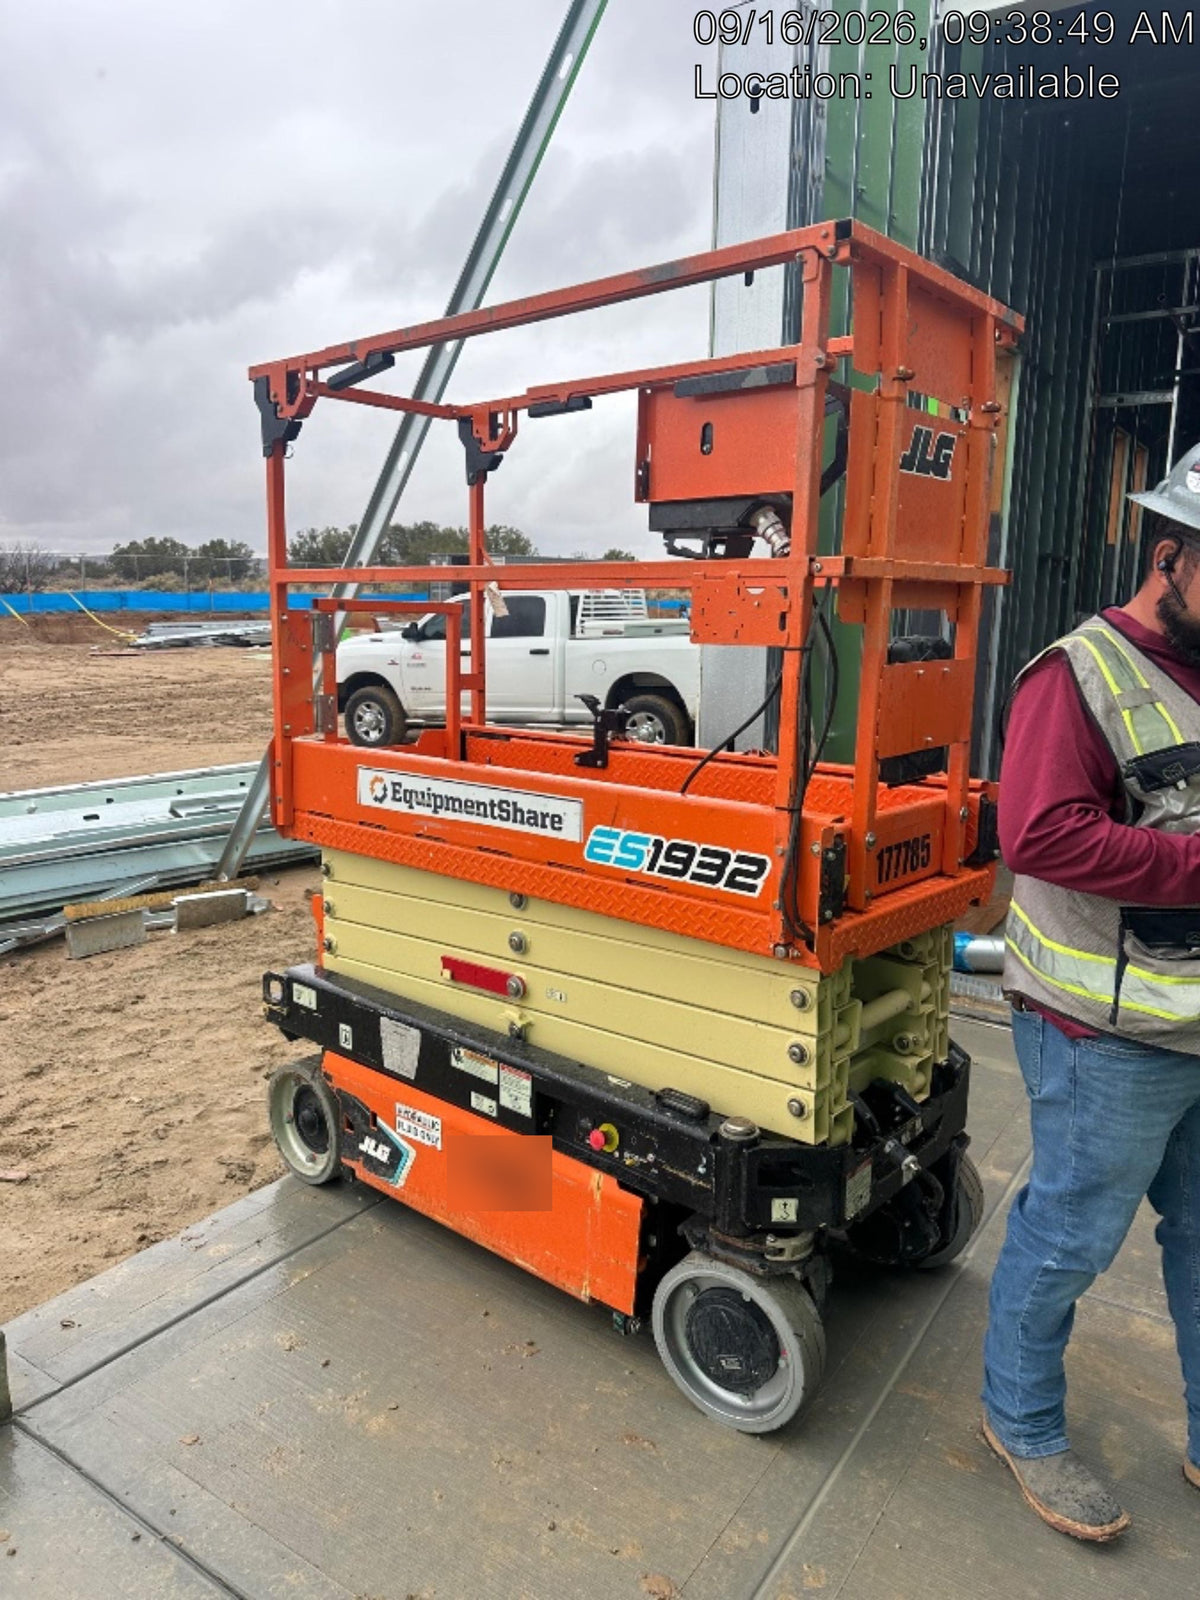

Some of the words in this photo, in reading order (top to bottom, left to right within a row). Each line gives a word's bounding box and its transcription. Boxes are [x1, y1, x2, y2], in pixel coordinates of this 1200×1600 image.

[900, 425, 956, 481] JLG
[390, 780, 564, 832] EquipmentShare
[584, 826, 771, 896] ES1932
